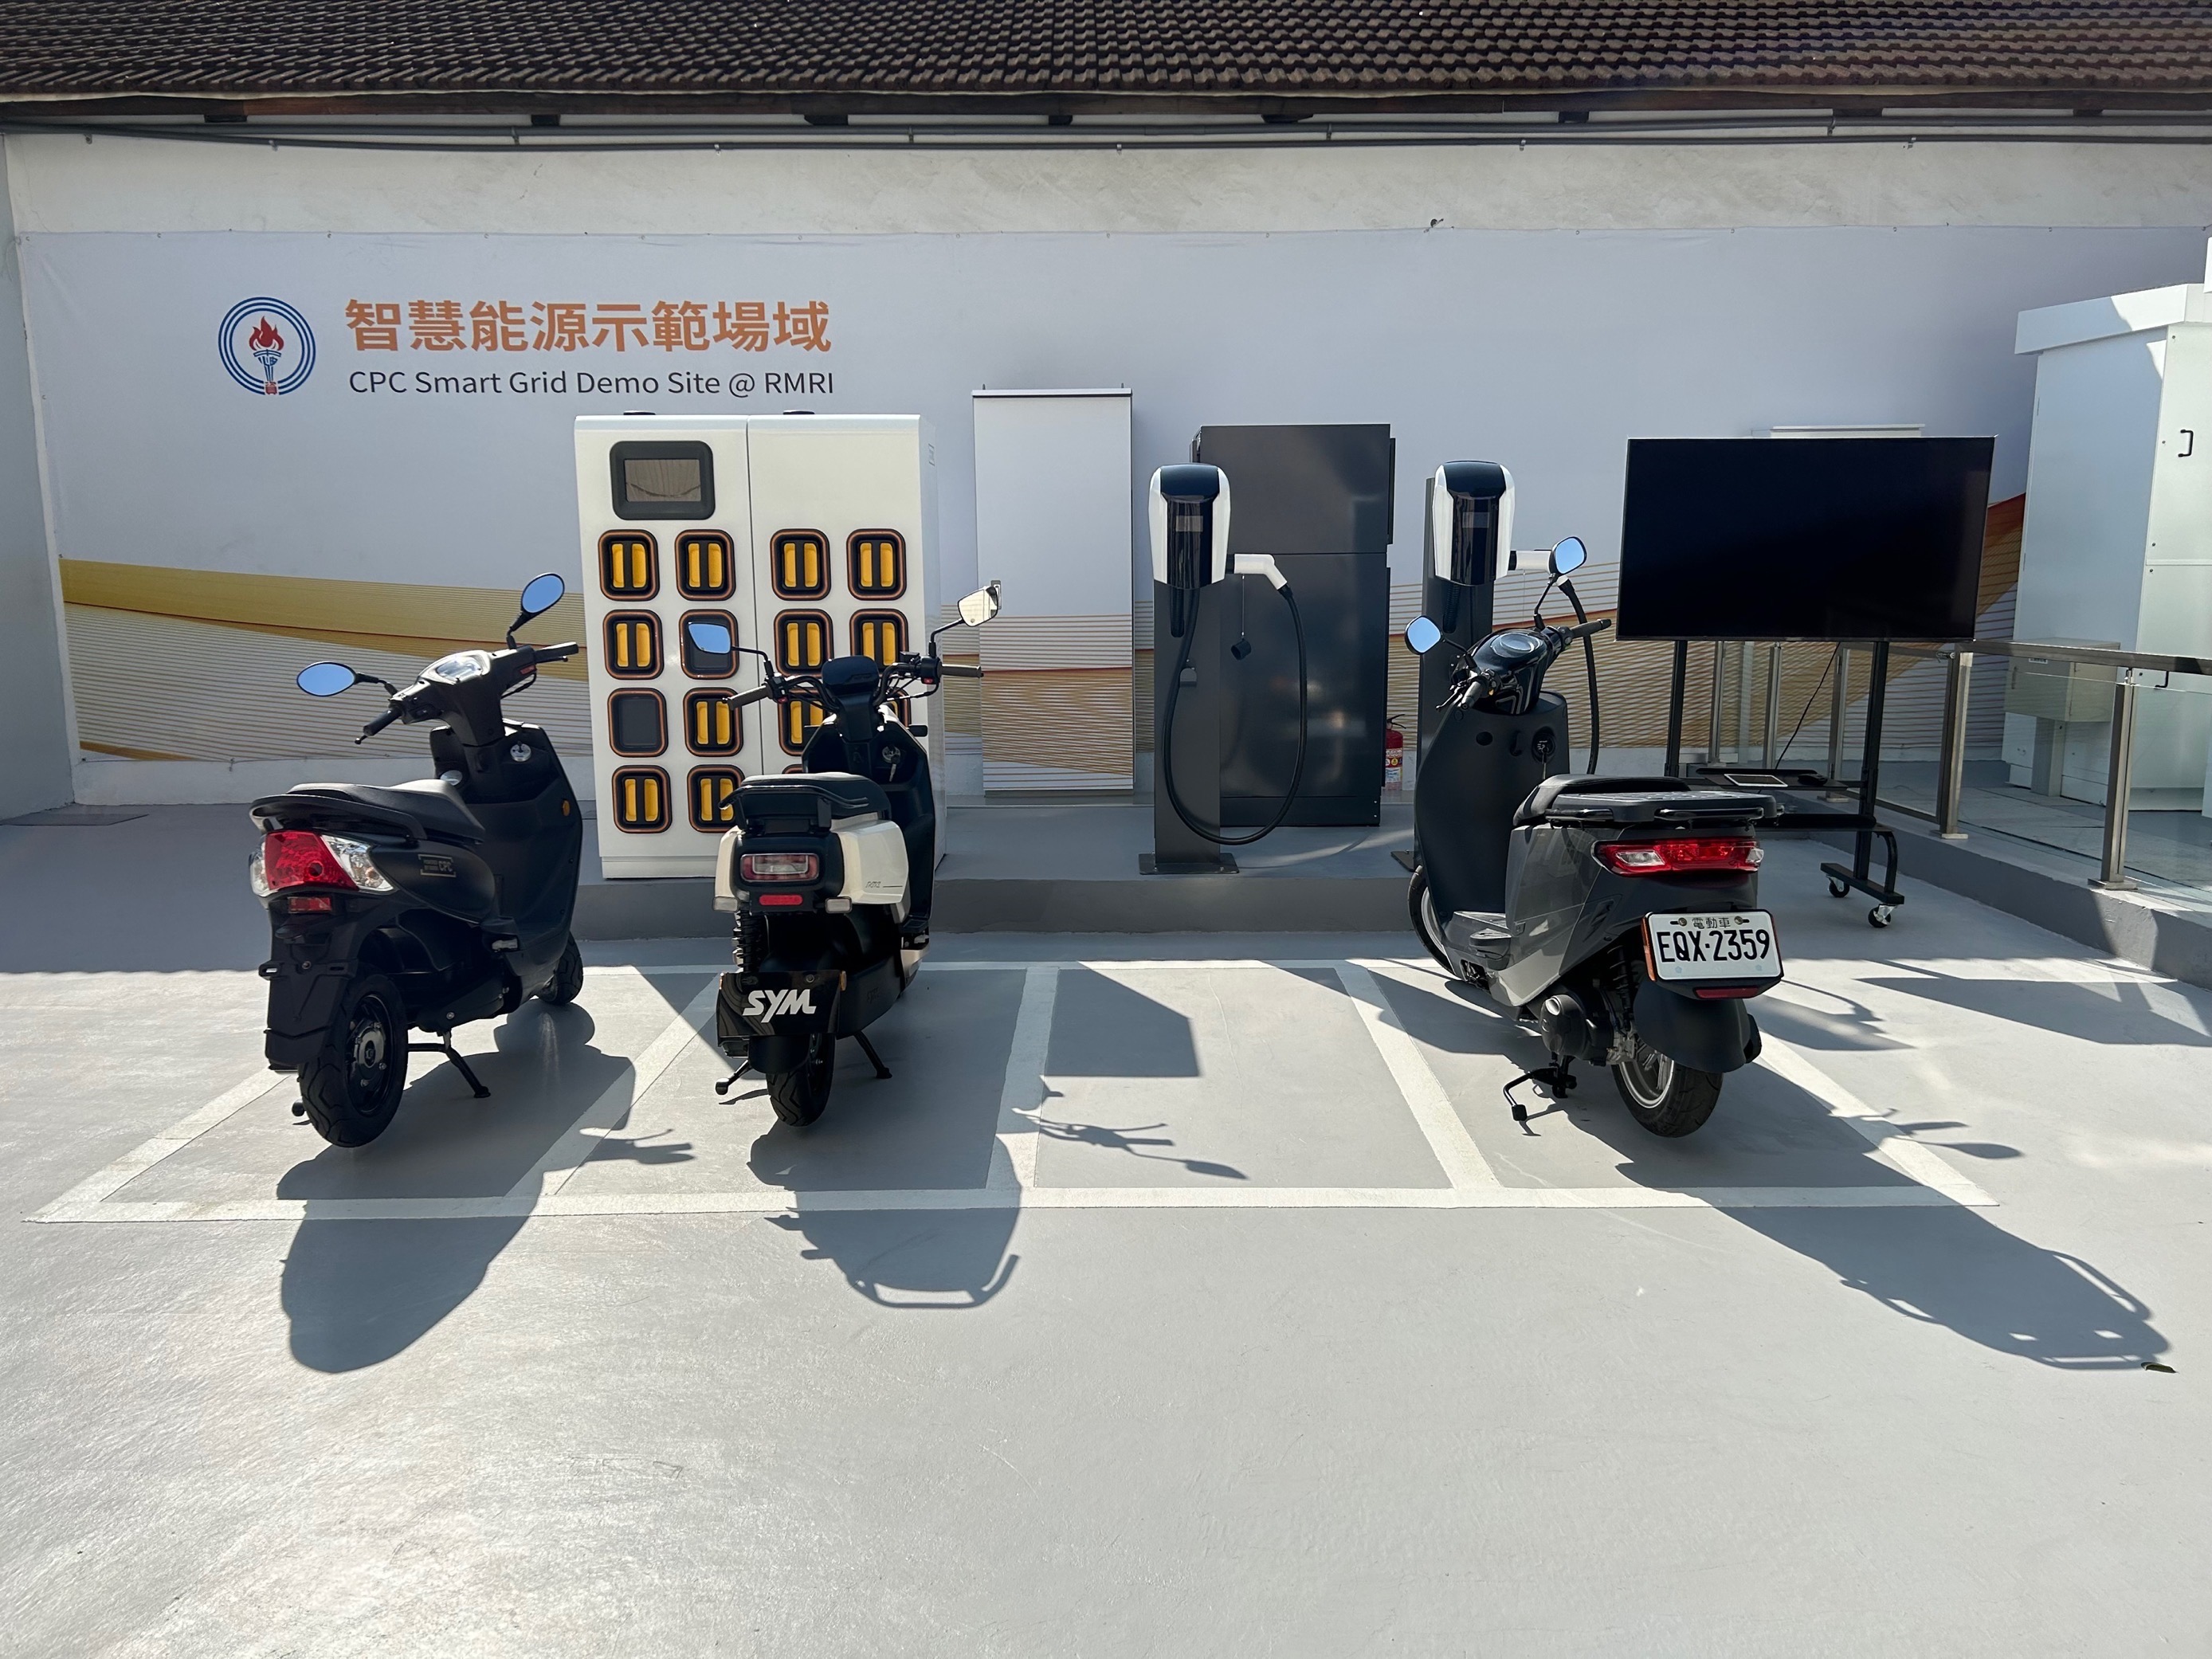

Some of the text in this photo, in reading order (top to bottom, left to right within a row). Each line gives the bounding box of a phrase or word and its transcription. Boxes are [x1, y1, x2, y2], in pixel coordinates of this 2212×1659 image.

[345, 298, 832, 352] 智慧能源示範場域
[349, 370, 833, 398] CPC Smart Grid Demo Site @ RMRI
[1692, 917, 1732, 929] 電動車
[742, 989, 817, 1023] SYM
